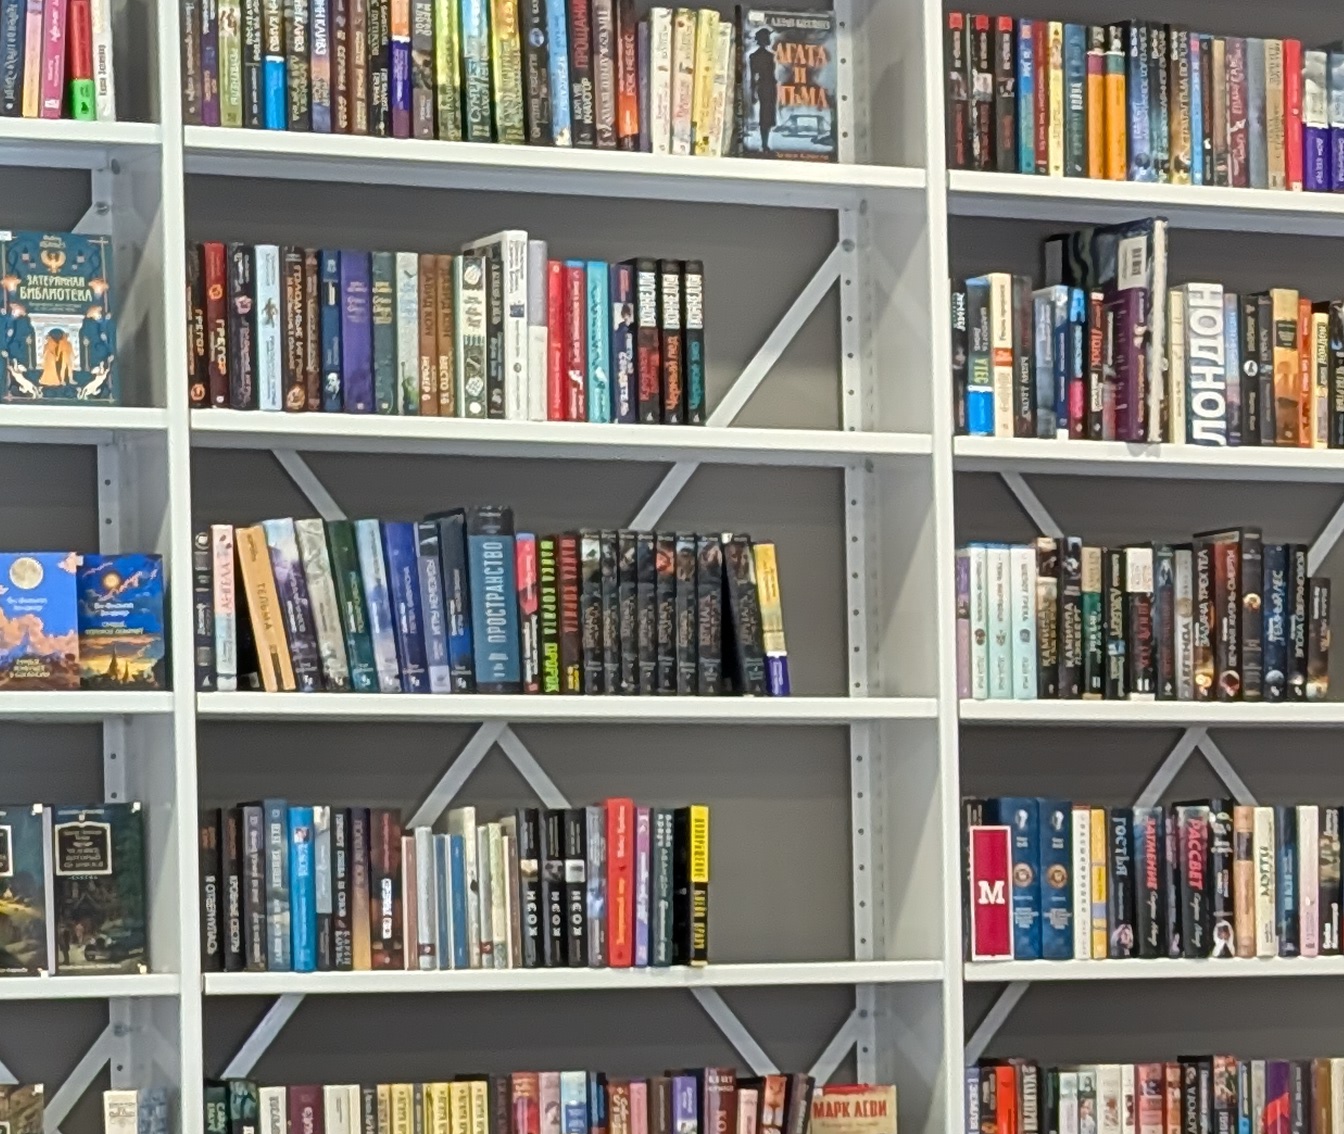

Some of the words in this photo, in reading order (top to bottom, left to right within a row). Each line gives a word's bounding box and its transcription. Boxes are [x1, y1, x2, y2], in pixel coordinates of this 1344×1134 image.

[1188, 284, 1226, 442] ЛОНДОН
[482, 541, 507, 643] ПРОСТРАНСТВО
[979, 881, 1005, 905] М
